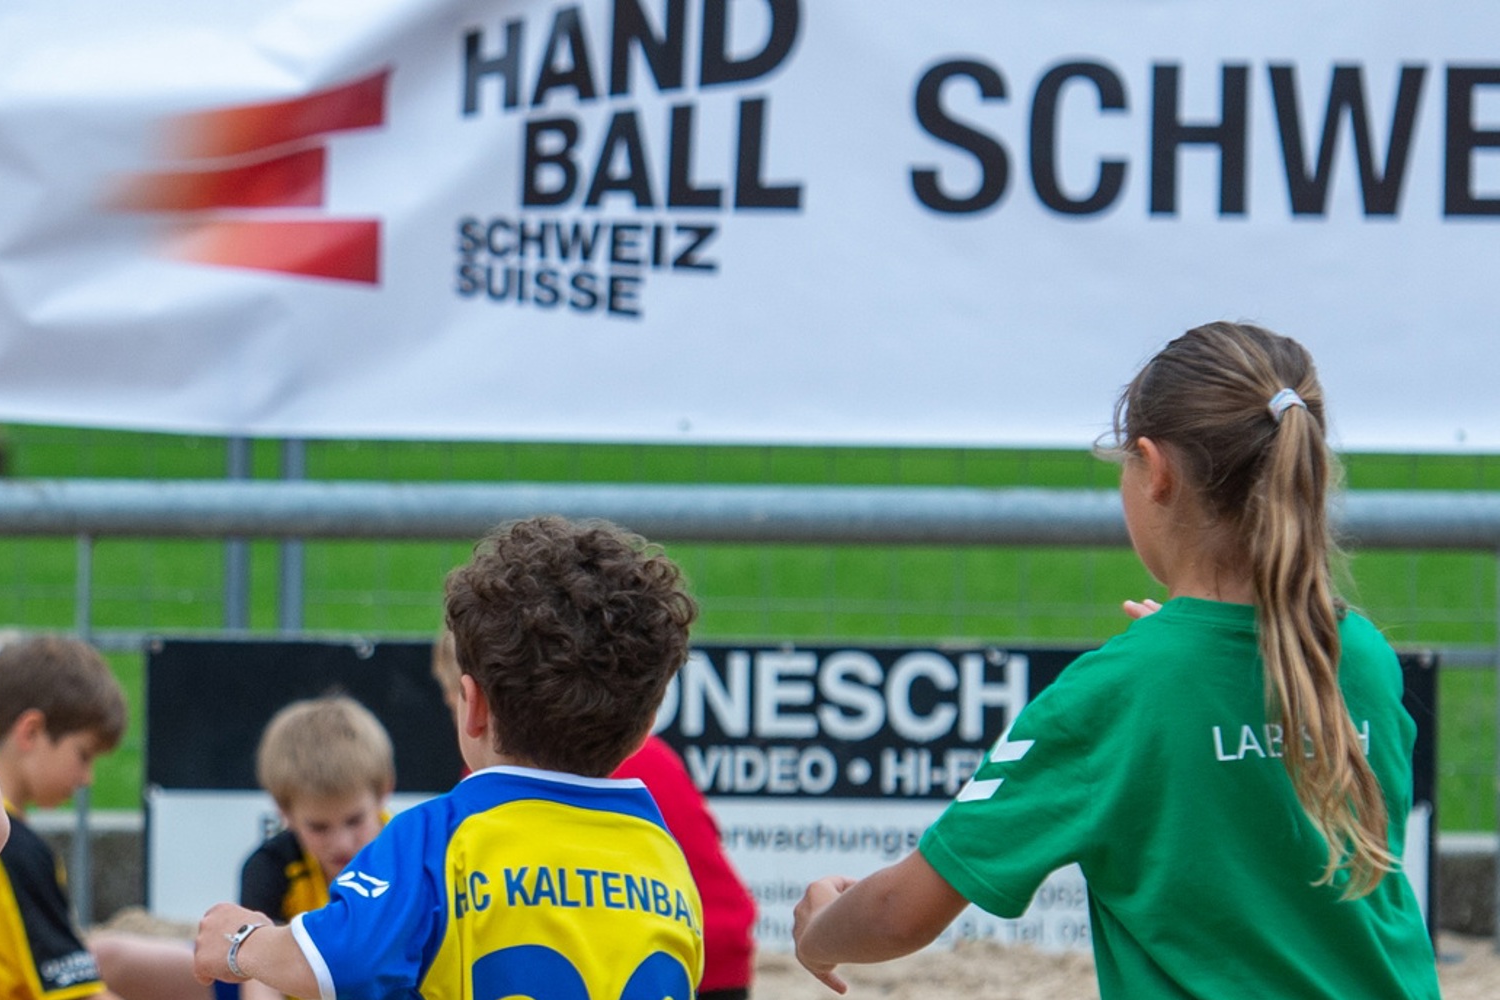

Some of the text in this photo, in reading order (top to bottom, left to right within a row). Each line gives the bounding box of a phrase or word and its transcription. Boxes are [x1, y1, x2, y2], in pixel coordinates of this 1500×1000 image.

[463, 0, 801, 117] HAND
[521, 98, 803, 210] BALL
[910, 59, 1500, 219] SCHWE
[460, 216, 719, 273] SCHWEIZ
[459, 263, 642, 318] SUISSE
[682, 745, 838, 794] VIDEO
[721, 822, 921, 861] rwachungs
[454, 865, 702, 937] HC KALTENBA
